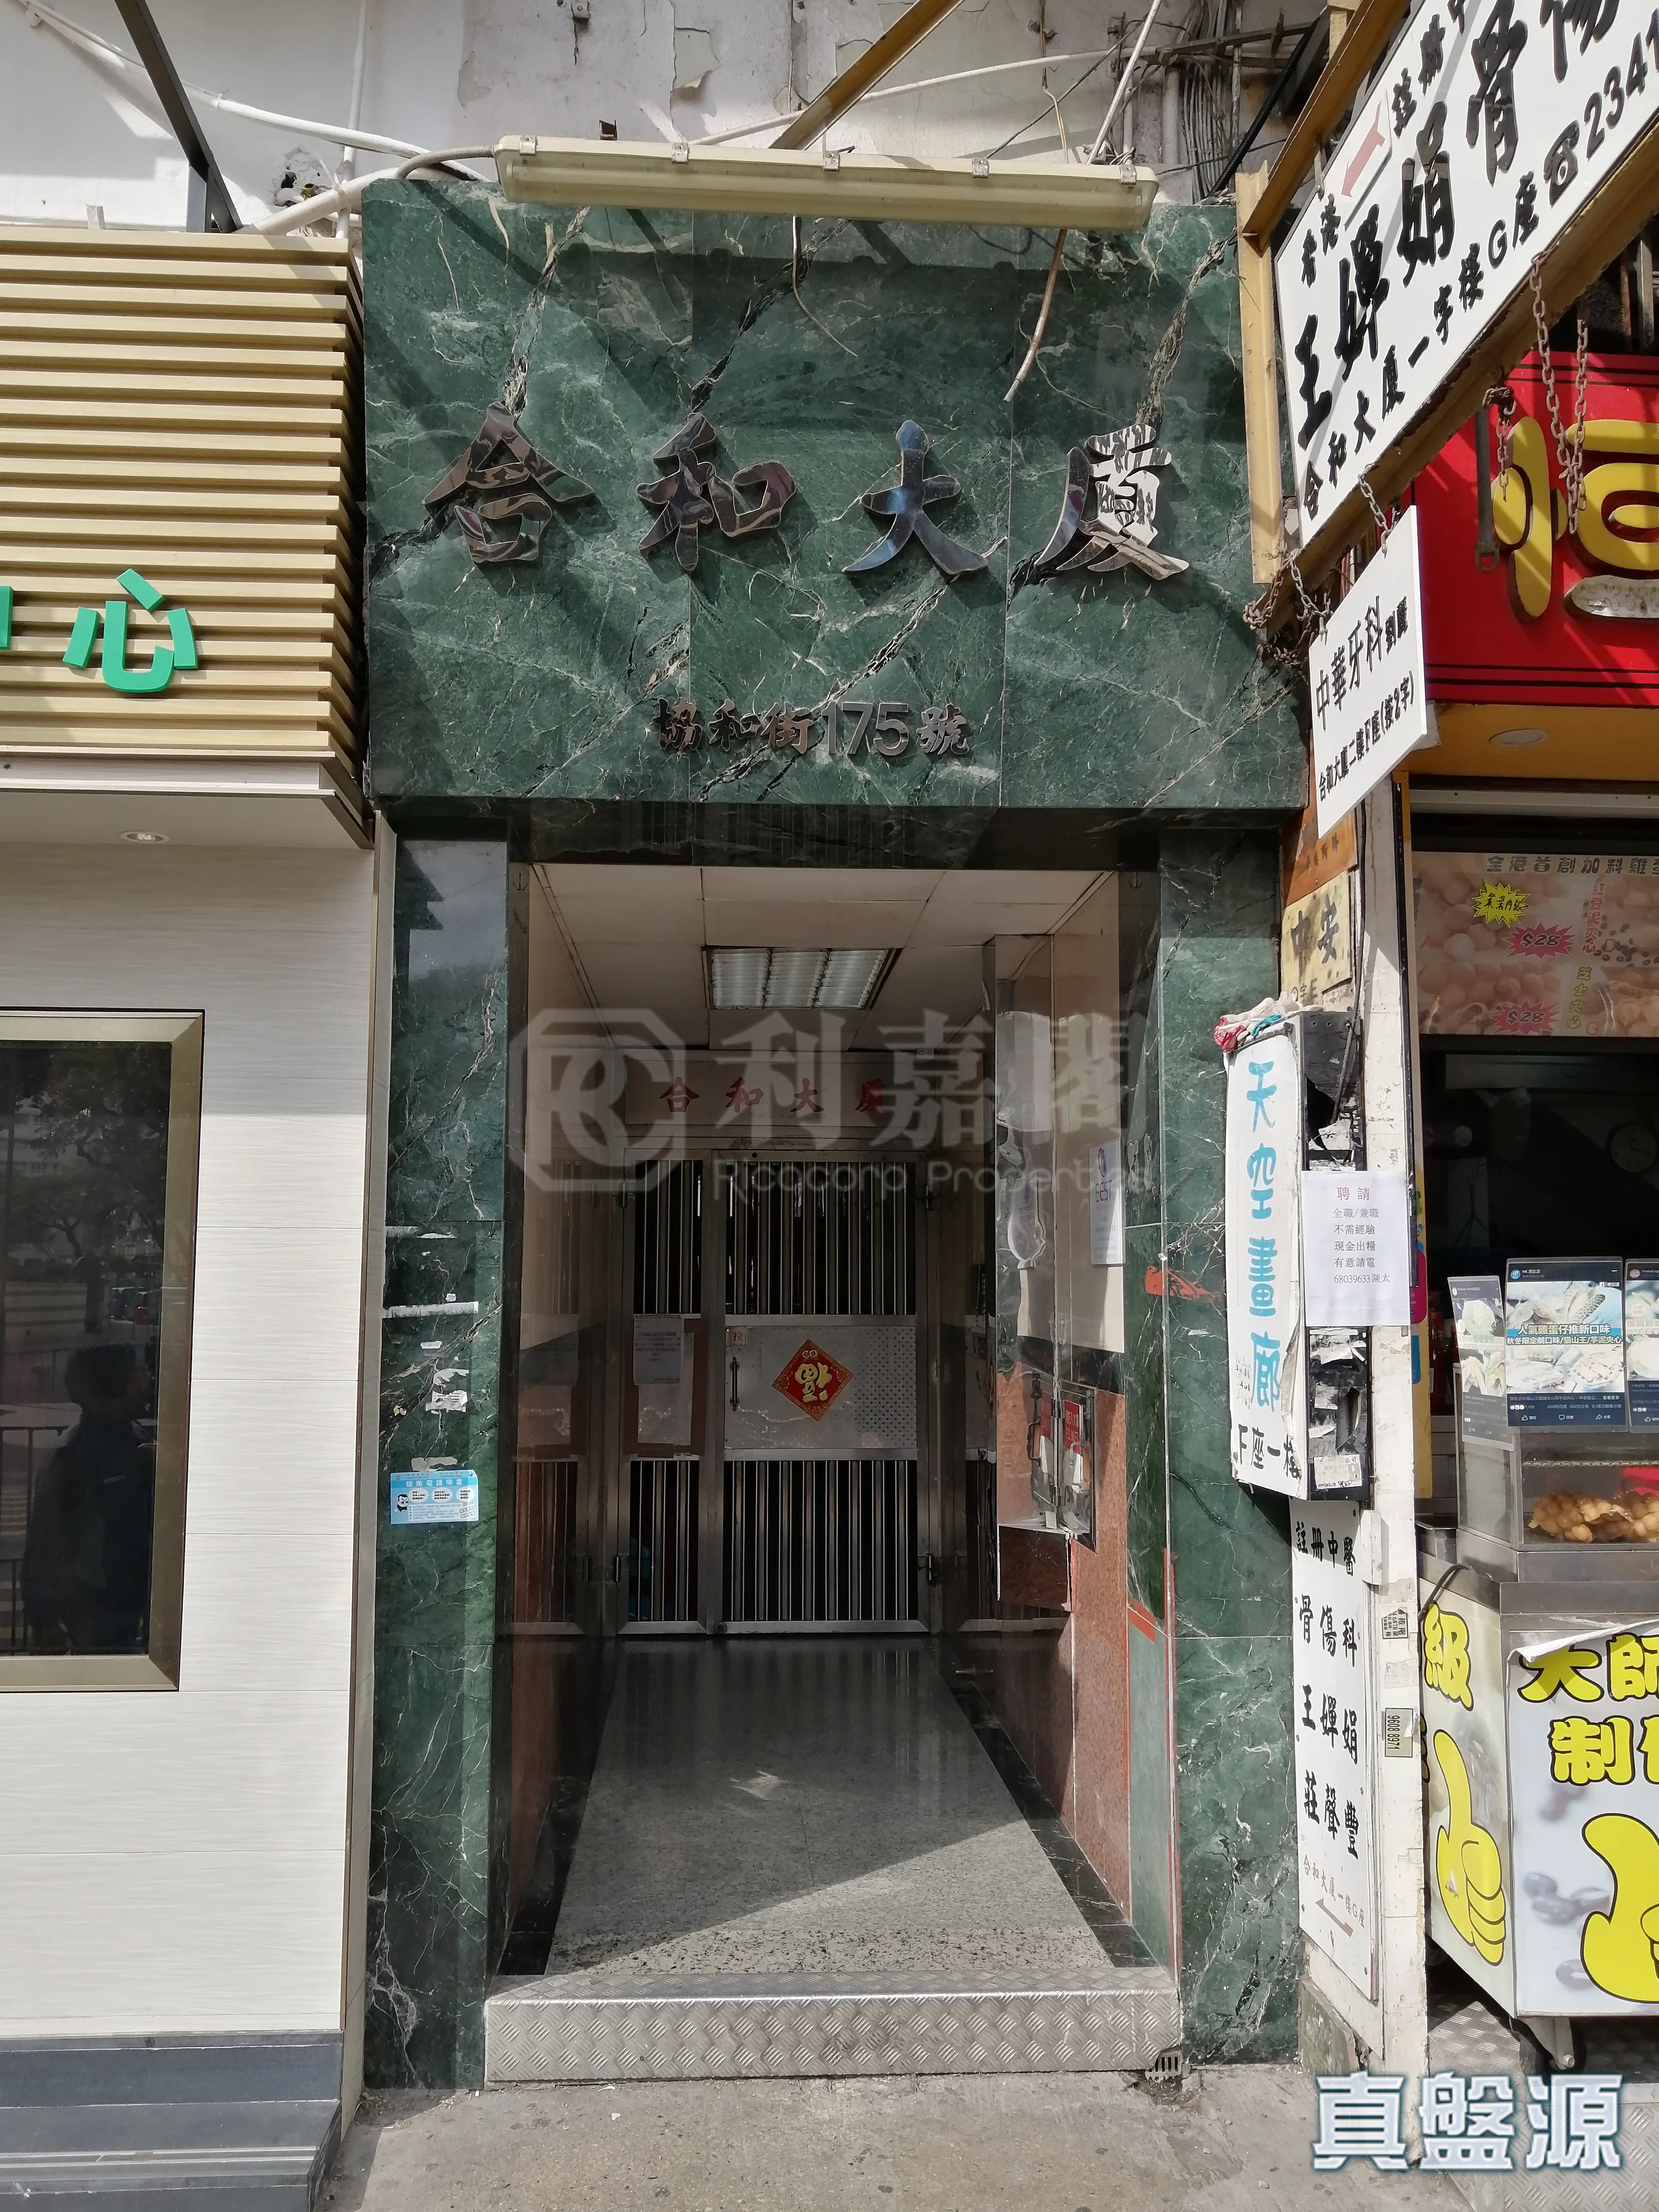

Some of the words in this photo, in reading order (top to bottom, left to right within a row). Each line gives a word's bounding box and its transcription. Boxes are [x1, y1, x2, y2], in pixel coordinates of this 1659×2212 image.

[0, 568, 198, 693] 心
[1316, 595, 1382, 732] 中華牙科
[653, 697, 970, 757] 協和街175號
[1520, 932, 1561, 947] $28
[1506, 1010, 1545, 1024] $28
[1336, 1187, 1370, 1201] 聘請
[1332, 1207, 1379, 1219] 全職/兼職
[1246, 1060, 1281, 1412] 天空畫廊
[1333, 1224, 1375, 1235] 不需經驗
[1334, 1241, 1376, 1252] 現金出糧
[1333, 1257, 1375, 1268] 有意請電
[1517, 1324, 1610, 1335] 人氣雞蛋仔推新口味
[1295, 1521, 1357, 1577] 註冊中醫
[1299, 1593, 1357, 1668] 骨傷科
[1302, 1684, 1358, 1765] 王嬋娟
[1387, 1715, 1401, 1732] 9608
[1387, 1732, 1401, 1750] 8971
[1547, 1714, 1659, 1786] 制
